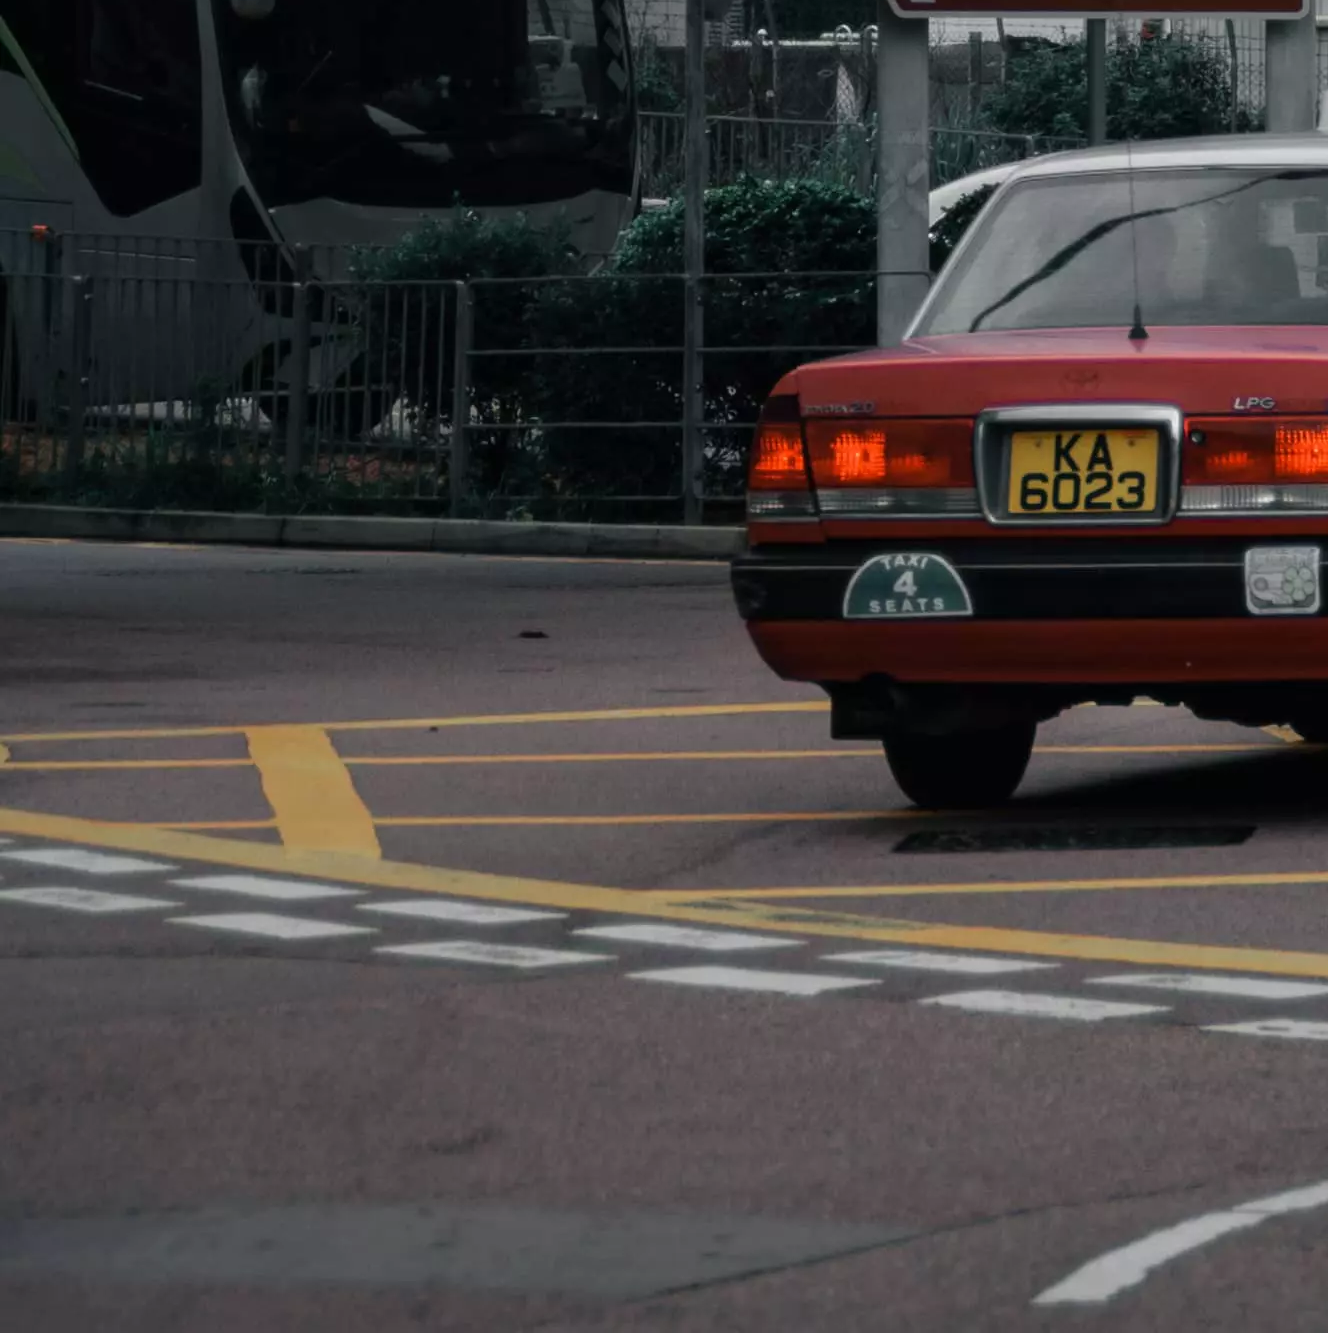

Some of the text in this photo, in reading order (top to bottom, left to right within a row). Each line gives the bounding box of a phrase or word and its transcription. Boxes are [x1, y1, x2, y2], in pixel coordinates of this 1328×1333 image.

[1233, 396, 1276, 411] LPG
[1054, 433, 1113, 472] KA
[1020, 471, 1146, 511] 6023
[881, 554, 929, 571] TAXI
[893, 570, 918, 597] 4
[869, 597, 945, 614] SEATS
